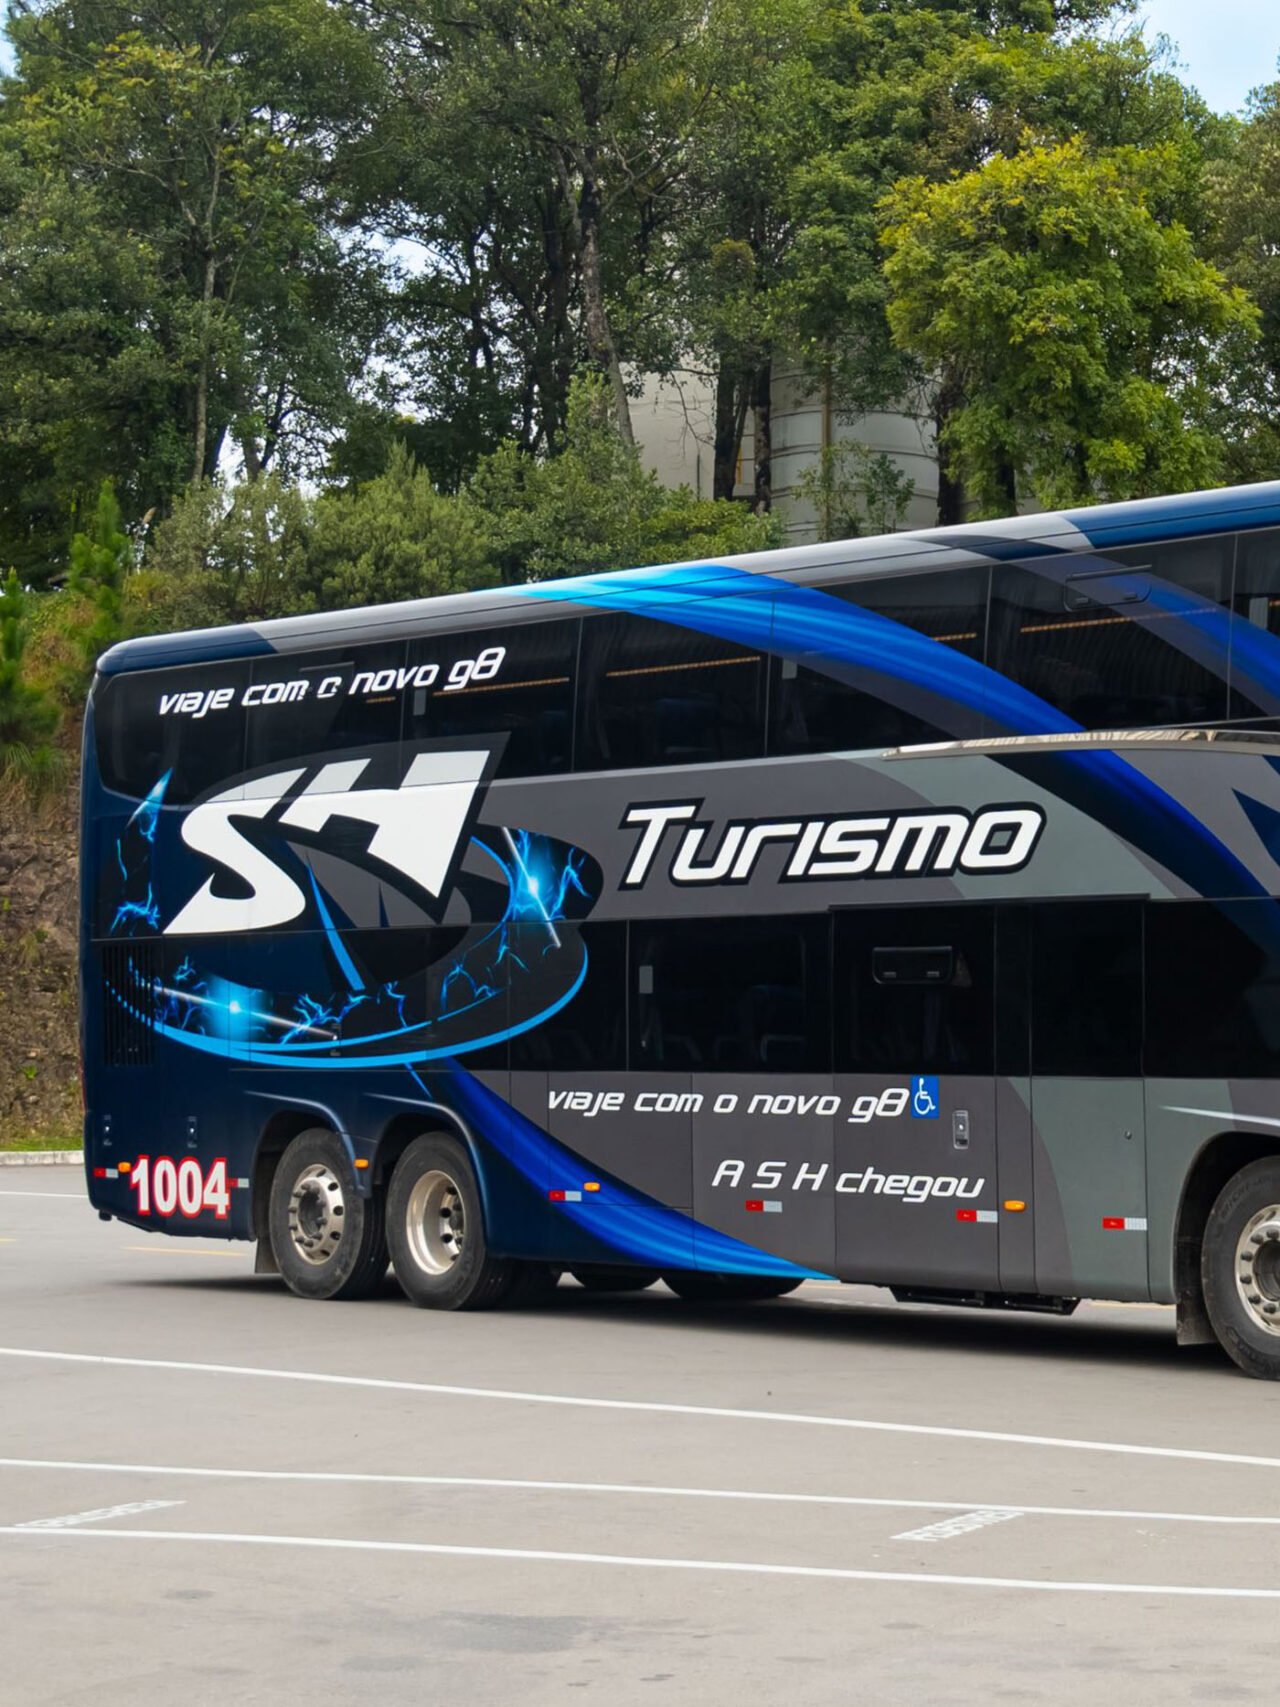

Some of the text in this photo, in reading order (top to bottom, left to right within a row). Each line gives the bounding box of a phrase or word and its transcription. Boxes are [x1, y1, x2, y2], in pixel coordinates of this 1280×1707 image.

[159, 687, 235, 718] viaje
[242, 682, 309, 706] com
[348, 664, 440, 695] novo
[443, 646, 506, 691] g8
[163, 750, 490, 934] SH
[622, 801, 1045, 888] Turismo
[548, 1088, 910, 1122] viaje com o novo g8
[130, 1155, 230, 1219] 1004
[712, 1160, 984, 1202] A S H chegou
